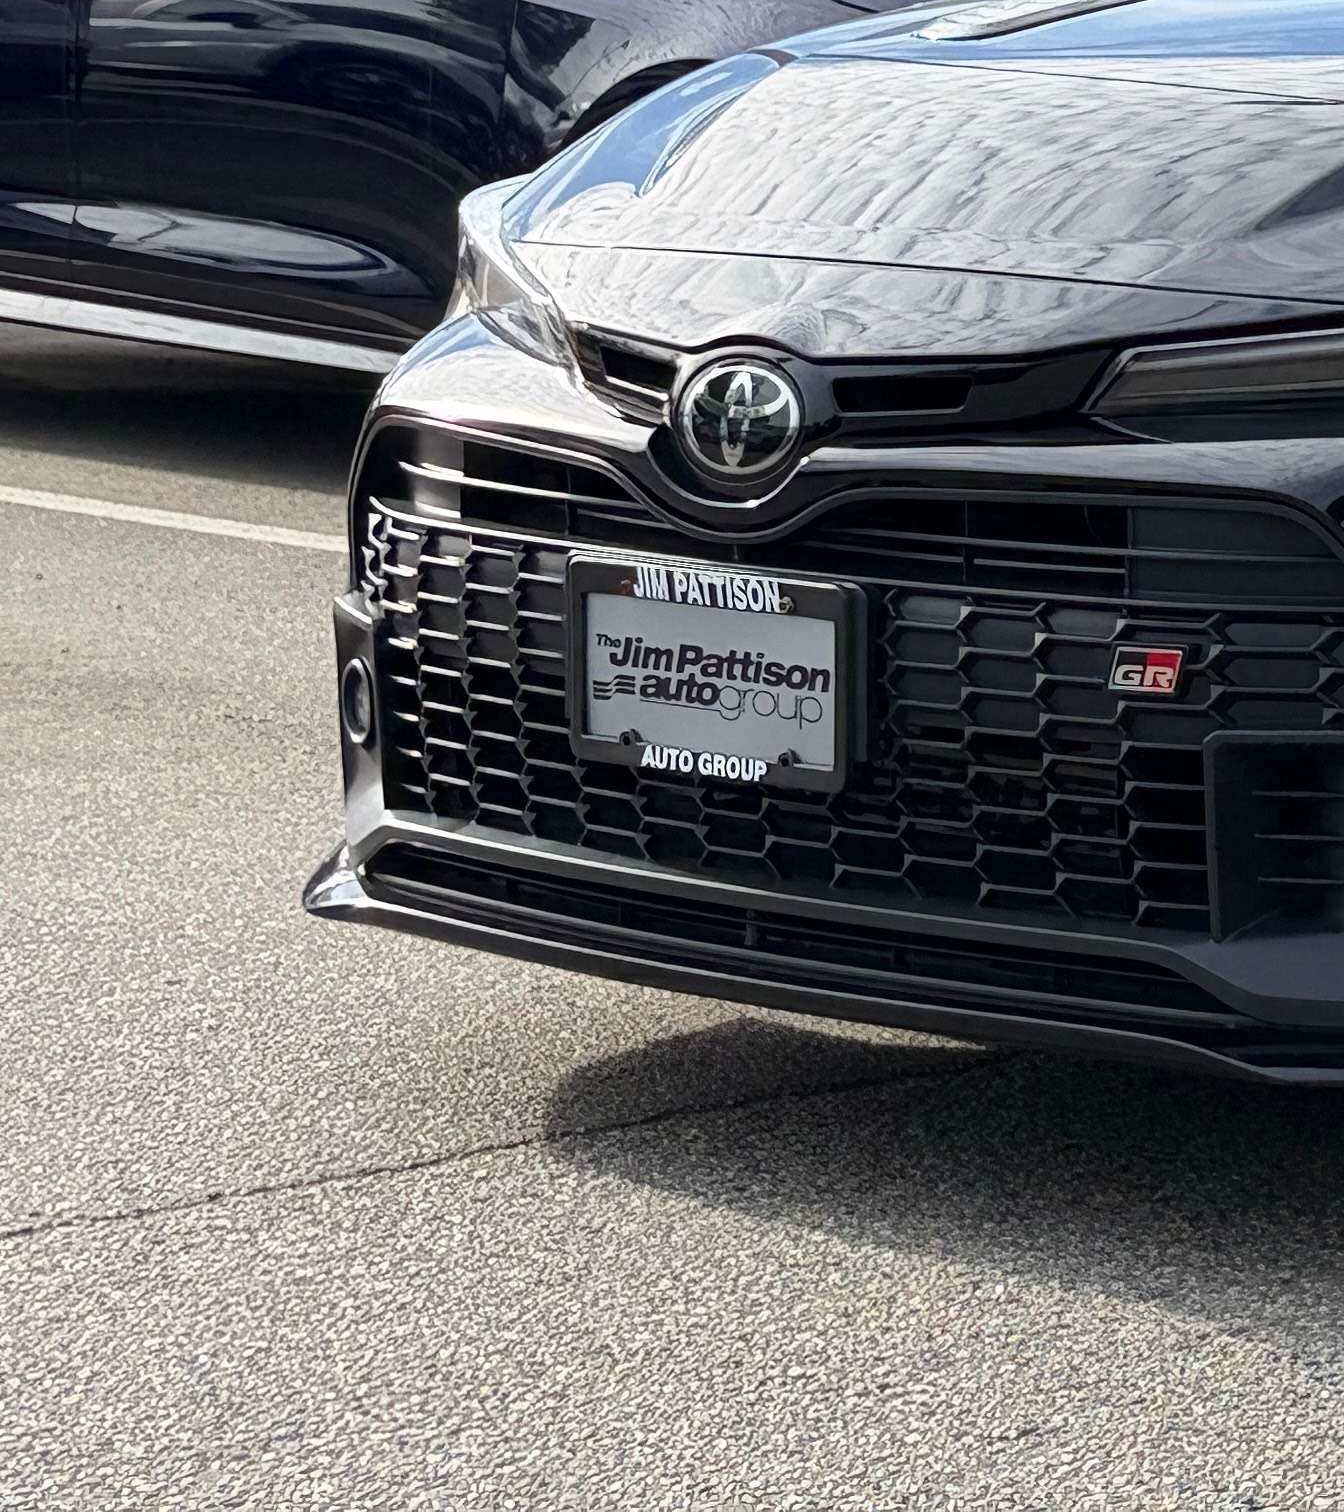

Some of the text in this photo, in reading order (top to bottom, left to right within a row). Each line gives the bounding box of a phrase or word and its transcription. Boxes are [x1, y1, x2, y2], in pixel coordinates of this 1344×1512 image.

[633, 566, 781, 614] JIM PATTISON
[596, 633, 830, 693] The Jim Pattison
[1114, 664, 1174, 688] GR
[641, 744, 768, 782] AUTO GROUP
